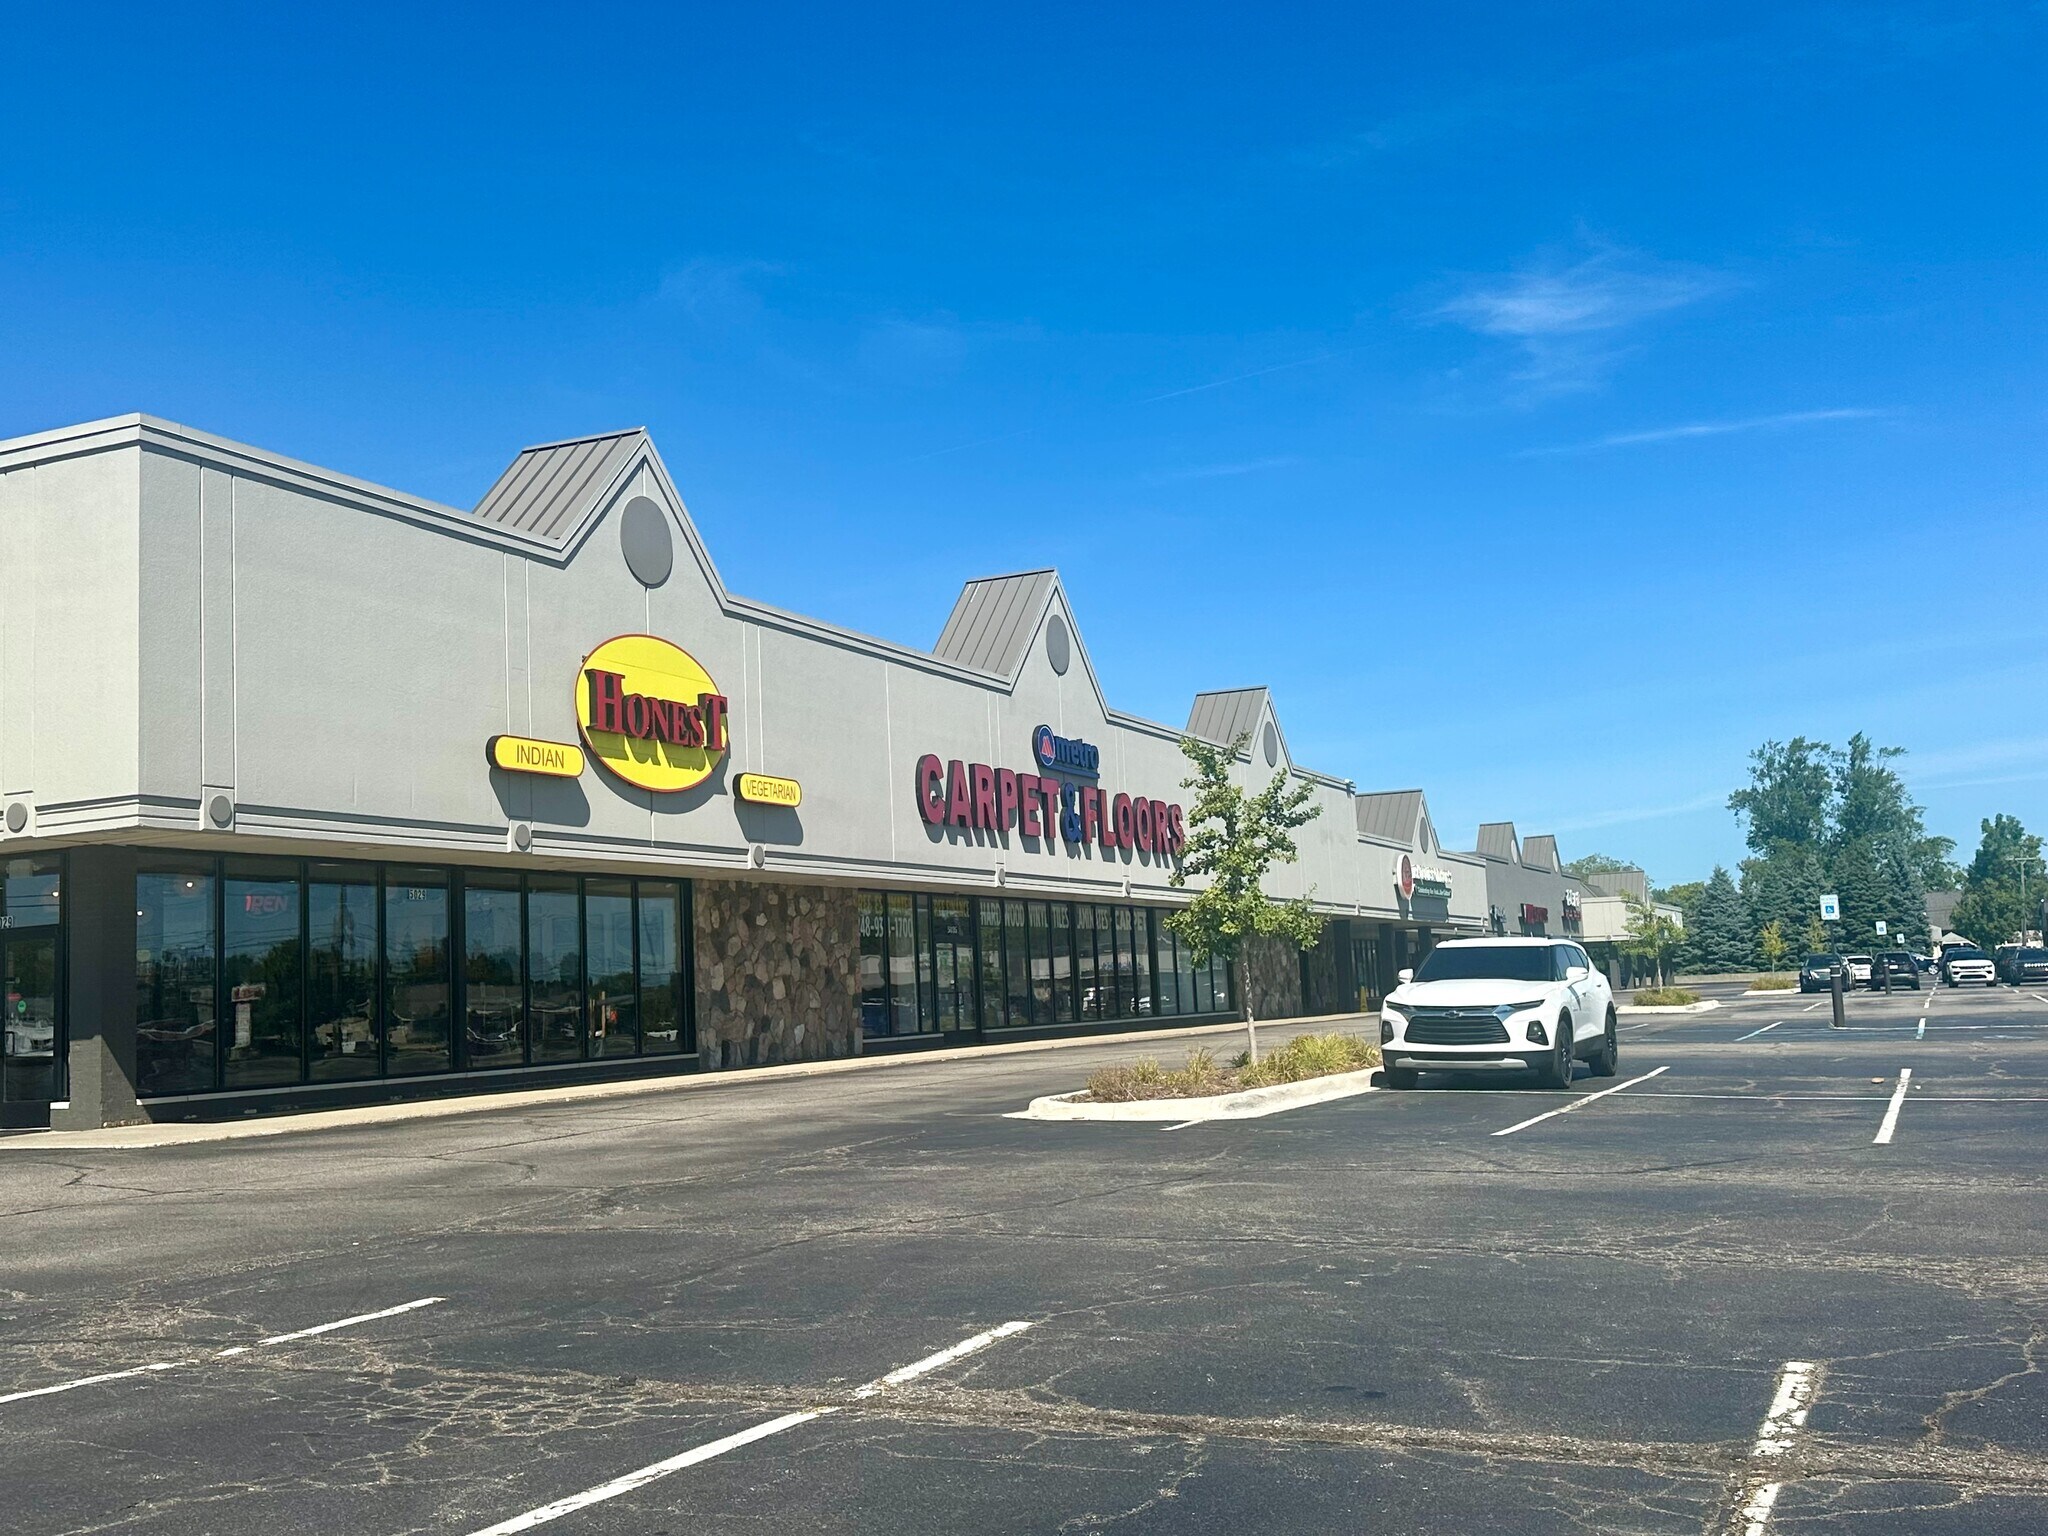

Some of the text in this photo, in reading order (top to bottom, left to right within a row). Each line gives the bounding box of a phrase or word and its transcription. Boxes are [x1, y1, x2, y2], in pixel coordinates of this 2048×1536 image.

[585, 668, 728, 751] HONEST
[515, 744, 565, 769] INDIAN
[1053, 736, 1099, 769] metro
[745, 779, 797, 802] VEGETARIAN
[916, 754, 1184, 854] CARPET & FLOORS
[1051, 906, 1070, 929] TILES
